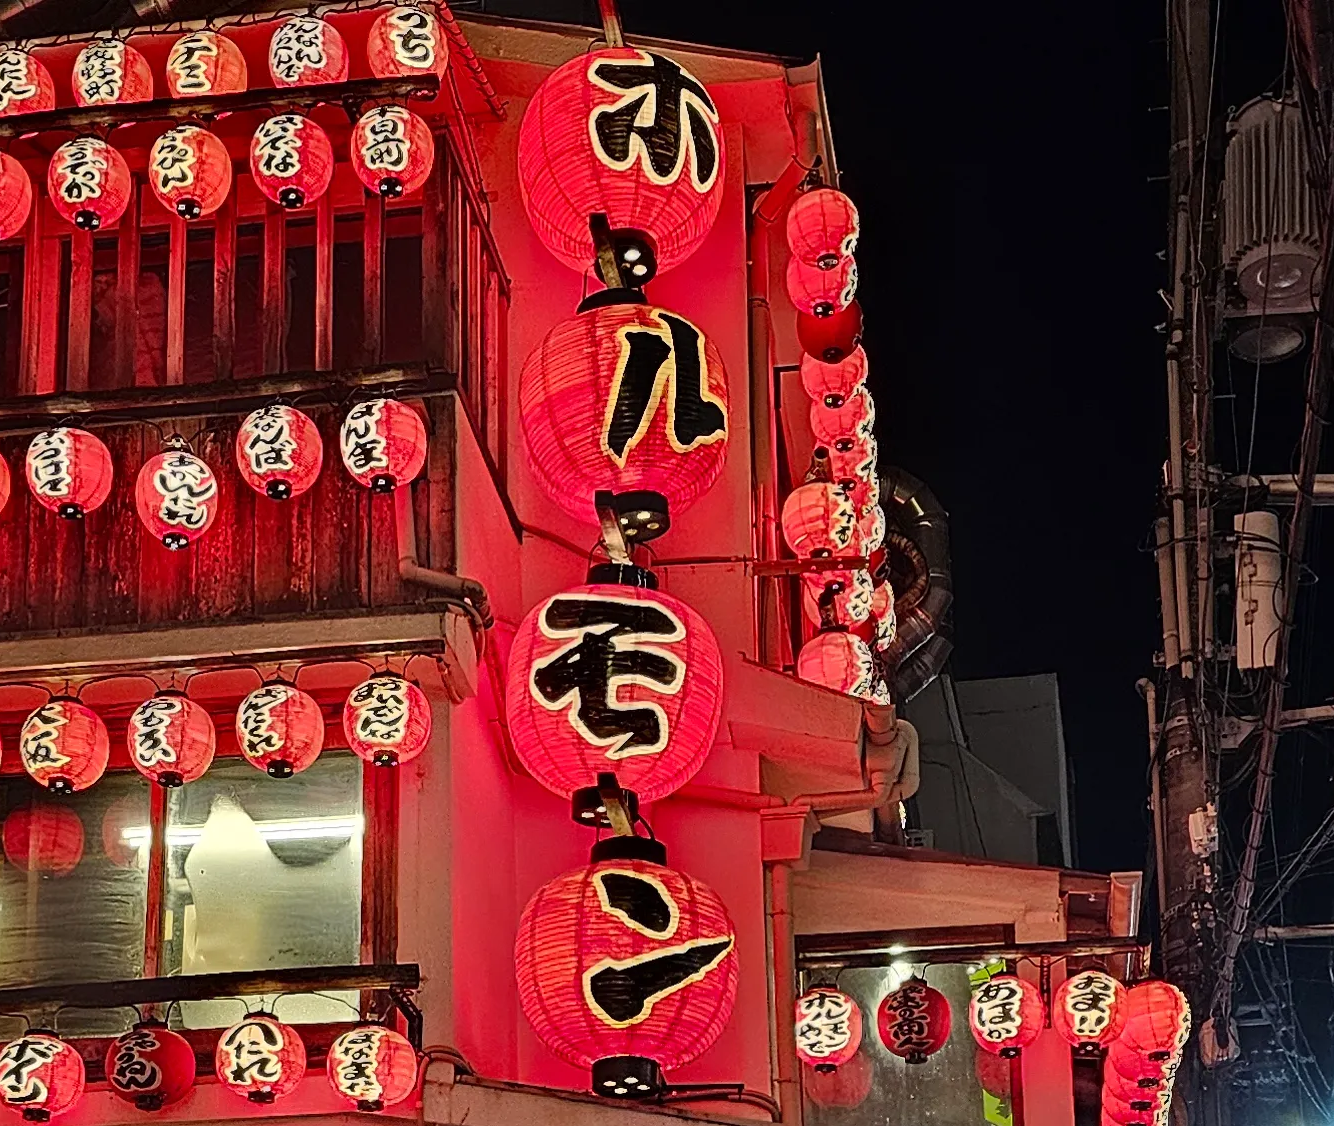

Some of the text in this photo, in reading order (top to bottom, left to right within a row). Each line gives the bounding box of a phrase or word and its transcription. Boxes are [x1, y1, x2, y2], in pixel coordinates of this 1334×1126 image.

[530, 48, 734, 1027] ホルモン
[977, 980, 1024, 1041] あほか
[2, 1041, 57, 1106] ボイン
[227, 1020, 288, 1086] へたれ
